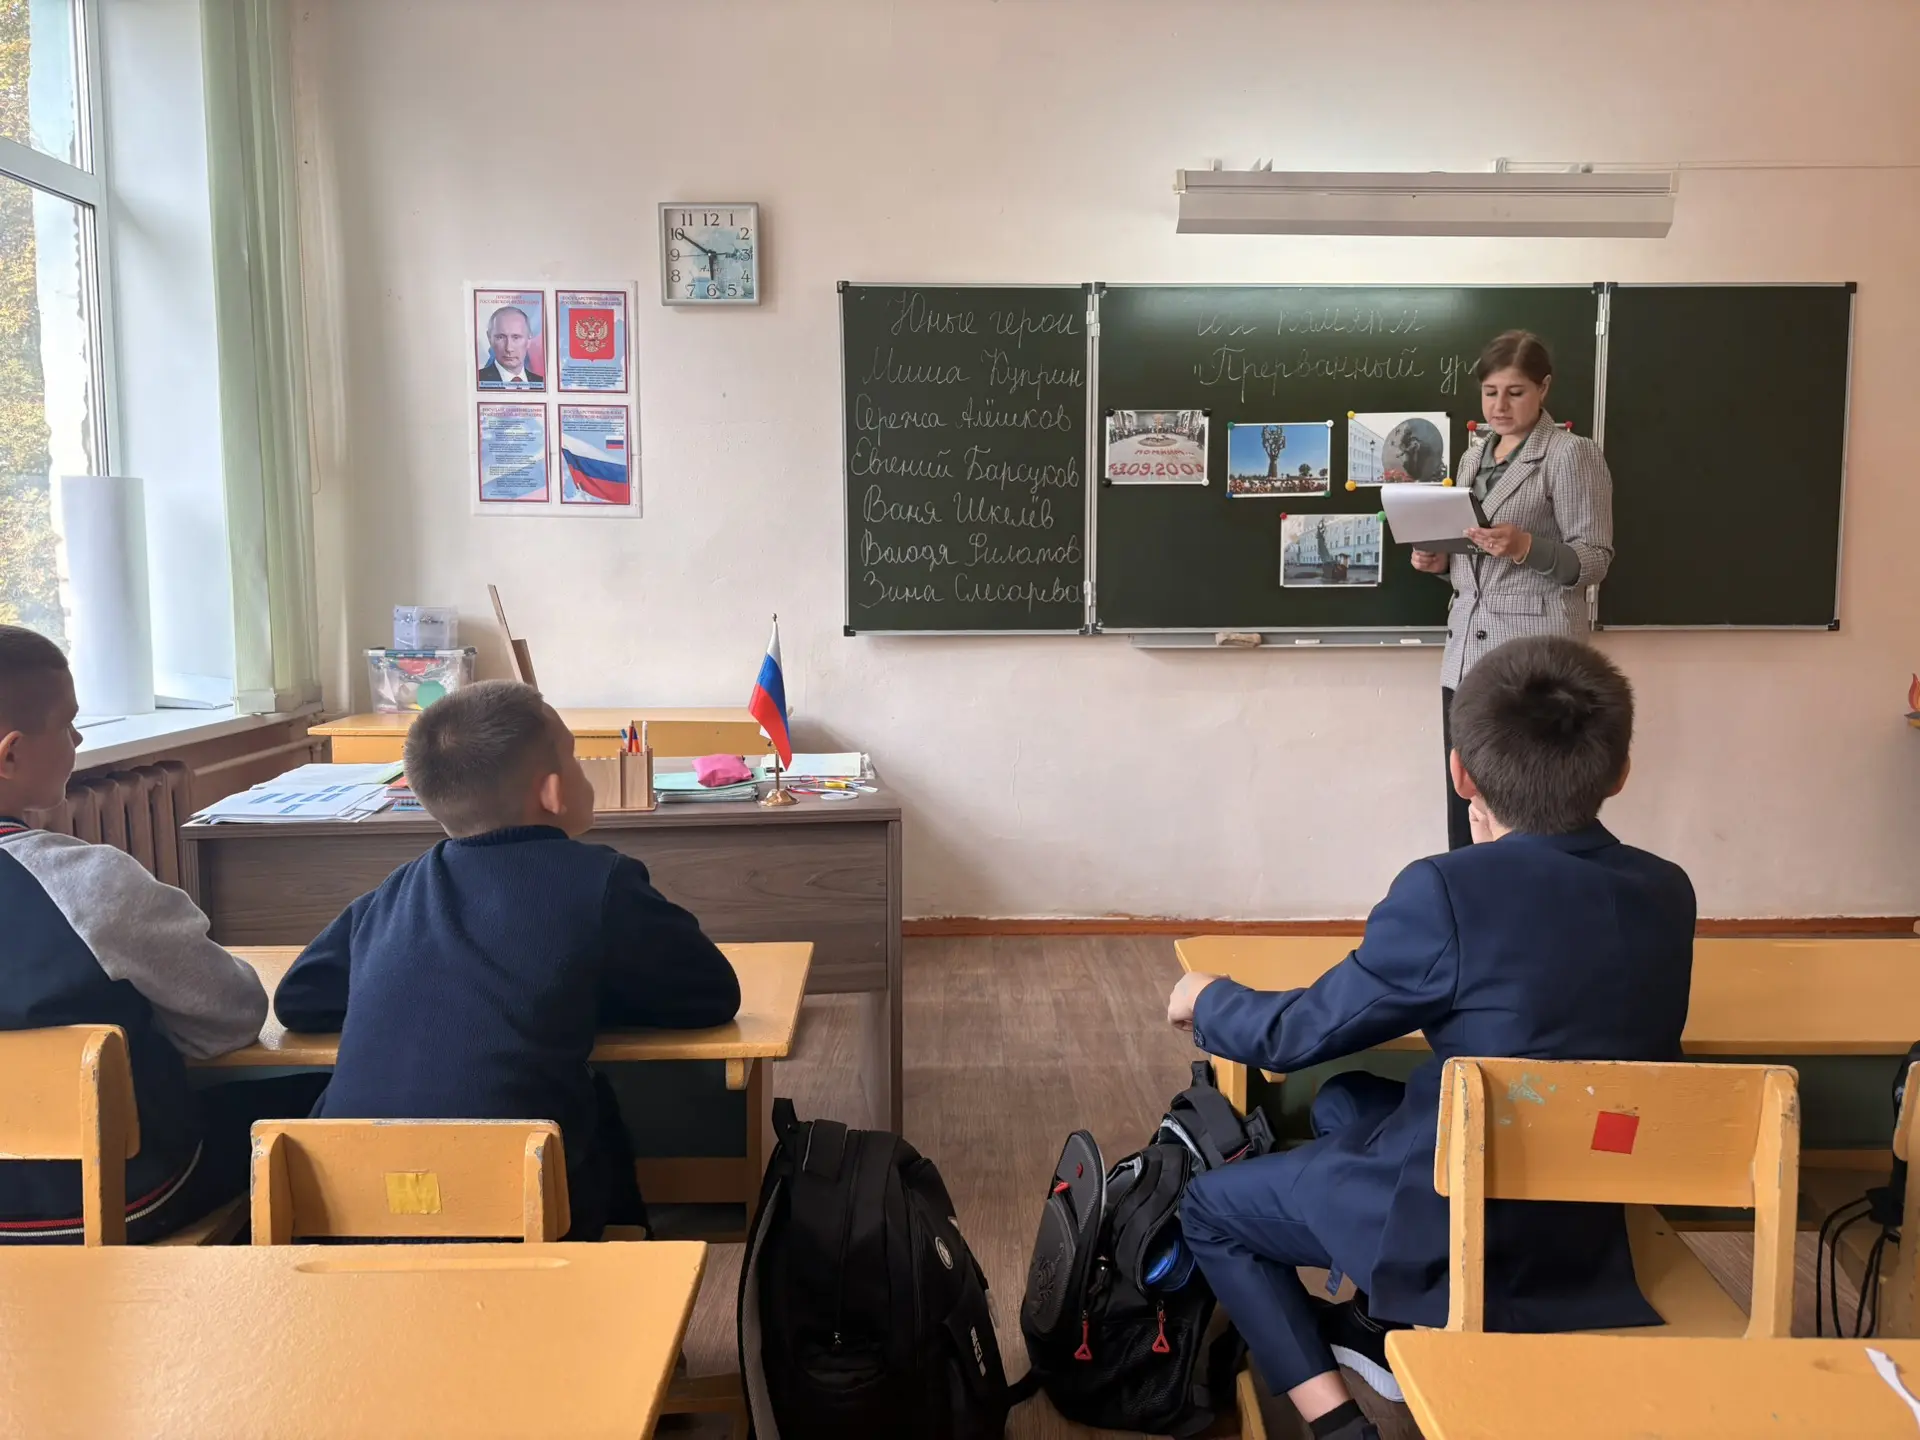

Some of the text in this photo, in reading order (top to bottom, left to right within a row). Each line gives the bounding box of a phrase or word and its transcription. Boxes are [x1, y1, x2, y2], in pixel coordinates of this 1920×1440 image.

[681, 213, 734, 226] 11 12 1
[671, 228, 684, 241] 10
[740, 227, 750, 240] 2
[670, 248, 680, 261] 9
[741, 249, 751, 261] 3
[671, 269, 681, 282] 8
[741, 270, 751, 283] 4
[687, 284, 737, 297] 7 6 5
[887, 291, 1080, 348] Юные герои
[862, 346, 1084, 400] Миша Куприн
[1440, 355, 1482, 395] ур
[856, 393, 947, 446] Сережа
[851, 437, 1080, 494] Евгений Барсуков
[863, 485, 943, 525] Ваня
[860, 528, 1081, 572] Володя Филатов
[855, 571, 945, 609] Зина
